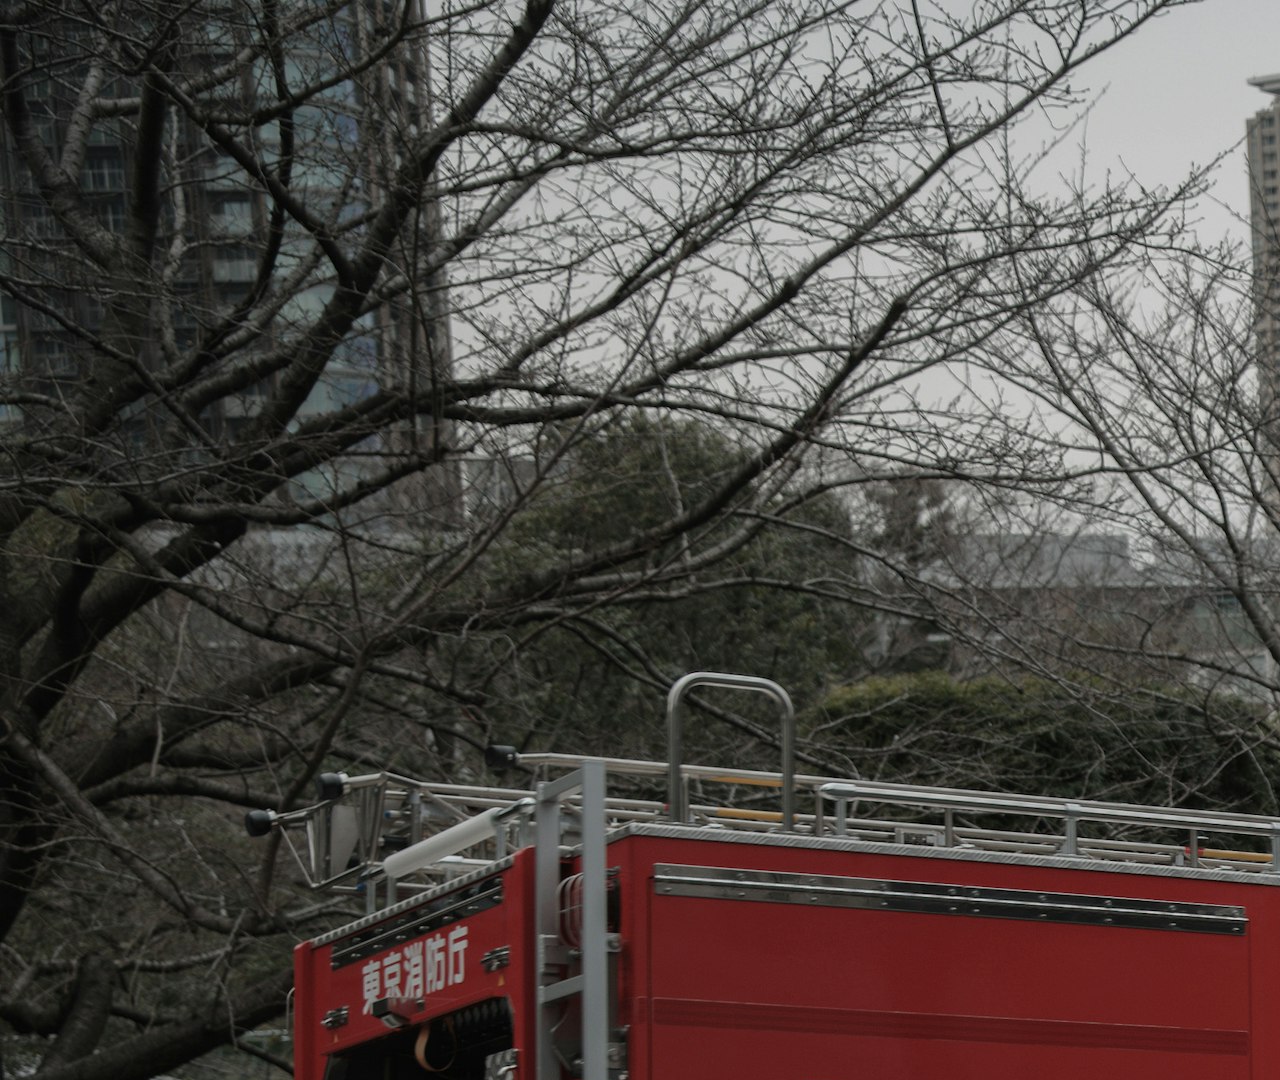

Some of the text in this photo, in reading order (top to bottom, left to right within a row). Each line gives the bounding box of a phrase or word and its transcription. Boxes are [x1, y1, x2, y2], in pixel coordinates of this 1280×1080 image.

[362, 925, 469, 1015] 東京消防庁
